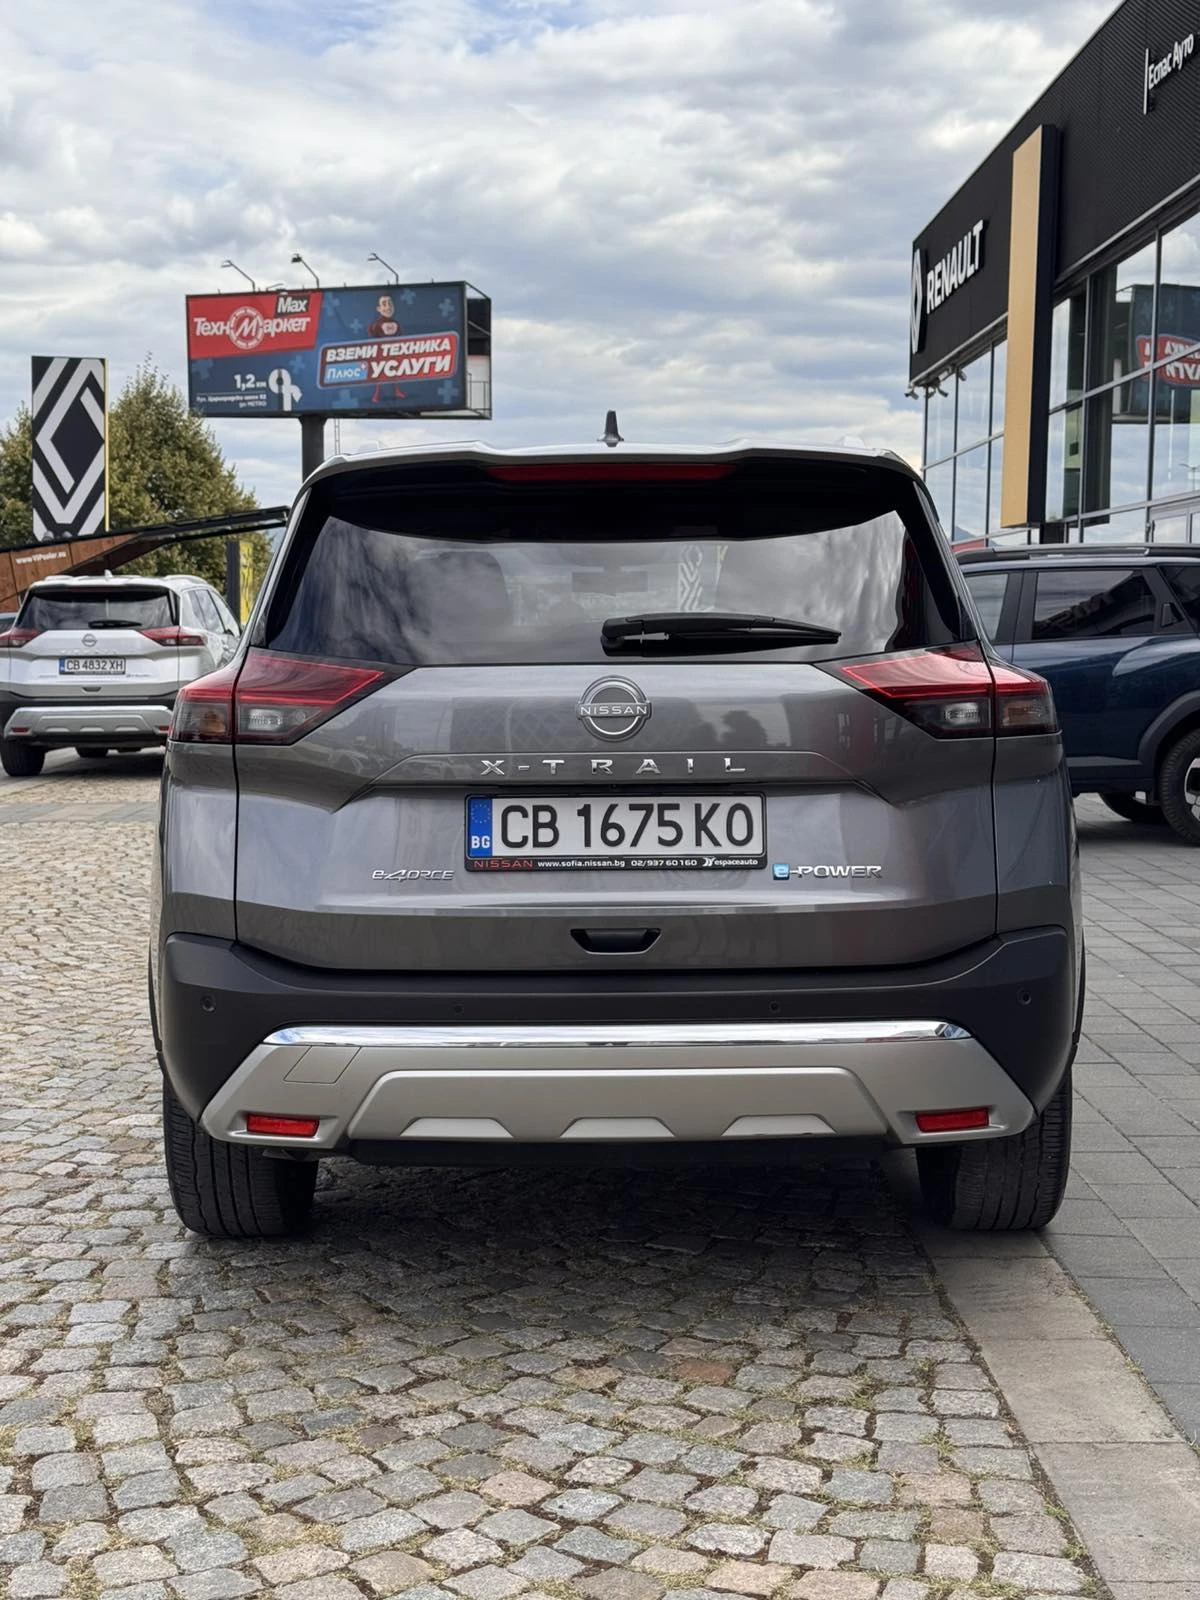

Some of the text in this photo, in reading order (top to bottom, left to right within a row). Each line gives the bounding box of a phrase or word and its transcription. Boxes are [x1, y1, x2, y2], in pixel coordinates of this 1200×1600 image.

[926, 219, 984, 315] RENAULT
[277, 297, 308, 313] Max
[326, 338, 451, 362] ВЗЕМИ ТЕХНИКА
[371, 355, 451, 379] УСЛУГИ
[233, 373, 256, 391] 1,2
[82, 660, 107, 670] 4832
[580, 704, 647, 716] NISSAN
[481, 757, 746, 776] X-TRAIL
[501, 804, 560, 849] CB
[577, 803, 684, 848] 1675
[471, 836, 490, 849] BG
[474, 859, 626, 868] NISSAN www.sofia.nissan.bg
[714, 858, 758, 866] espaceauto
[773, 864, 883, 879] e-POWER
